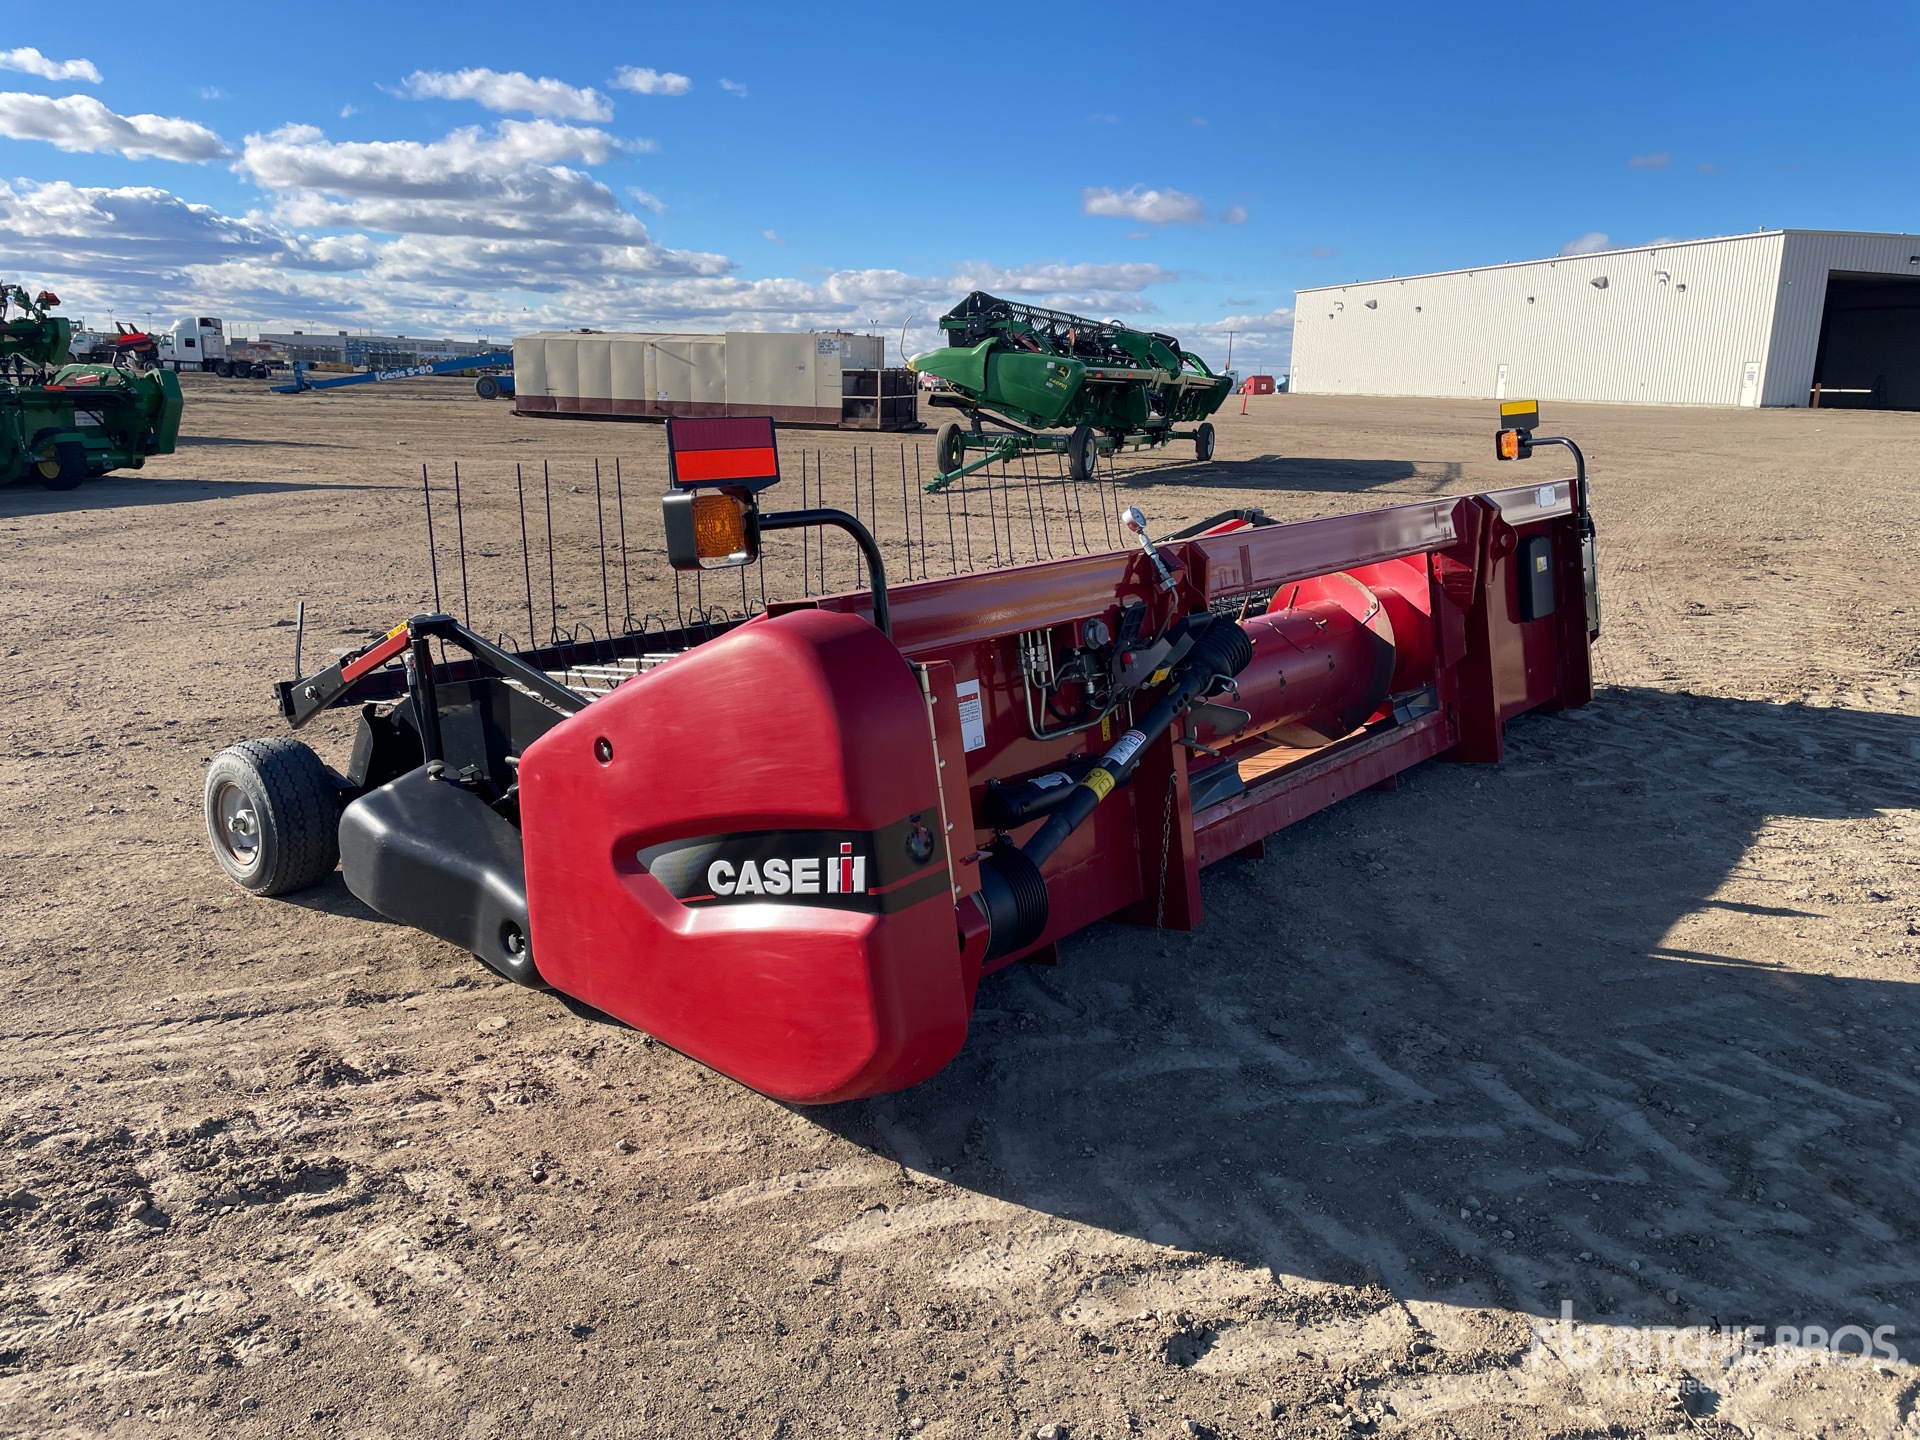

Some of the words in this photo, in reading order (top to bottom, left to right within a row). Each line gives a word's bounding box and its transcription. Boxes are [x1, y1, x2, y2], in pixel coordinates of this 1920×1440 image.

[380, 370, 406, 380] Genie
[407, 364, 434, 376] S-80
[707, 858, 821, 896] CASE
